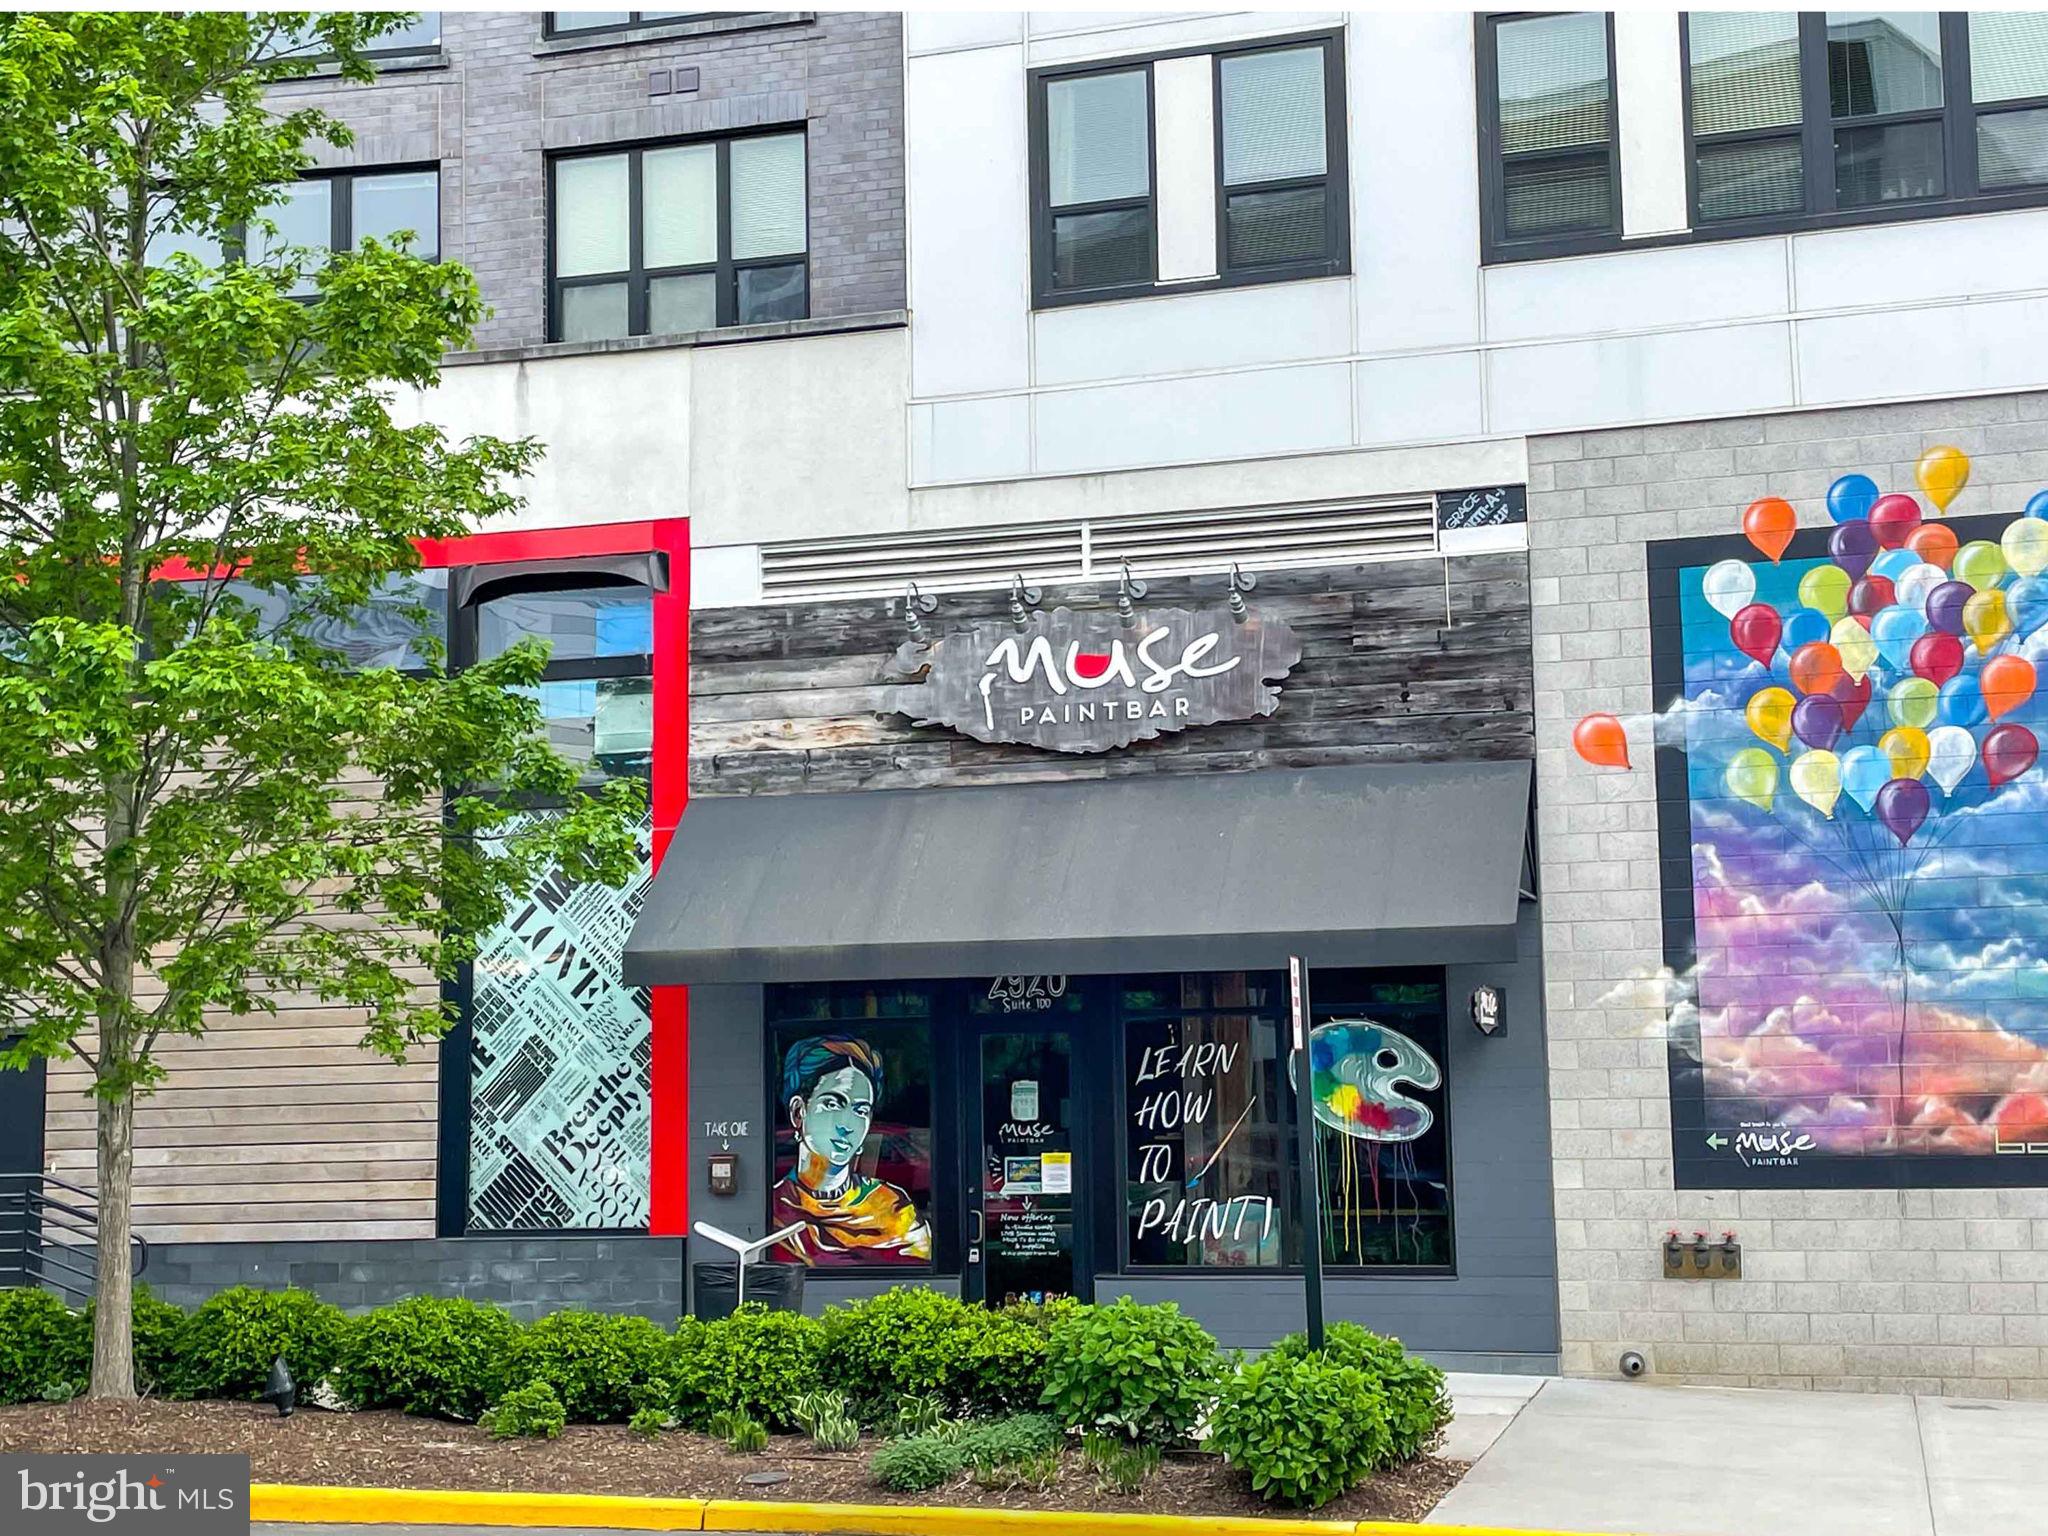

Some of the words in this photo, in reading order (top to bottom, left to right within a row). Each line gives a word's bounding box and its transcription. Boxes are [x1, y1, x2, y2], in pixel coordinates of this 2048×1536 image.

[1446, 492, 1480, 529] GRACE
[1020, 697, 1190, 726] PAINTBAR
[510, 903, 611, 1012] LOVE
[988, 975, 1066, 999] 2920
[1002, 997, 1031, 1013] Suite
[1036, 998, 1052, 1010] 100
[1135, 1041, 1238, 1086] LEARN
[542, 1062, 632, 1157] Breathe
[1134, 1089, 1213, 1130] HOW
[492, 1133, 520, 1161] SET
[557, 1090, 642, 1175] Deeply
[1139, 1144, 1172, 1184] TO
[1751, 1157, 1799, 1166] PAINTBAR
[536, 1183, 578, 1224] GOALS
[584, 1152, 648, 1216] YOGA
